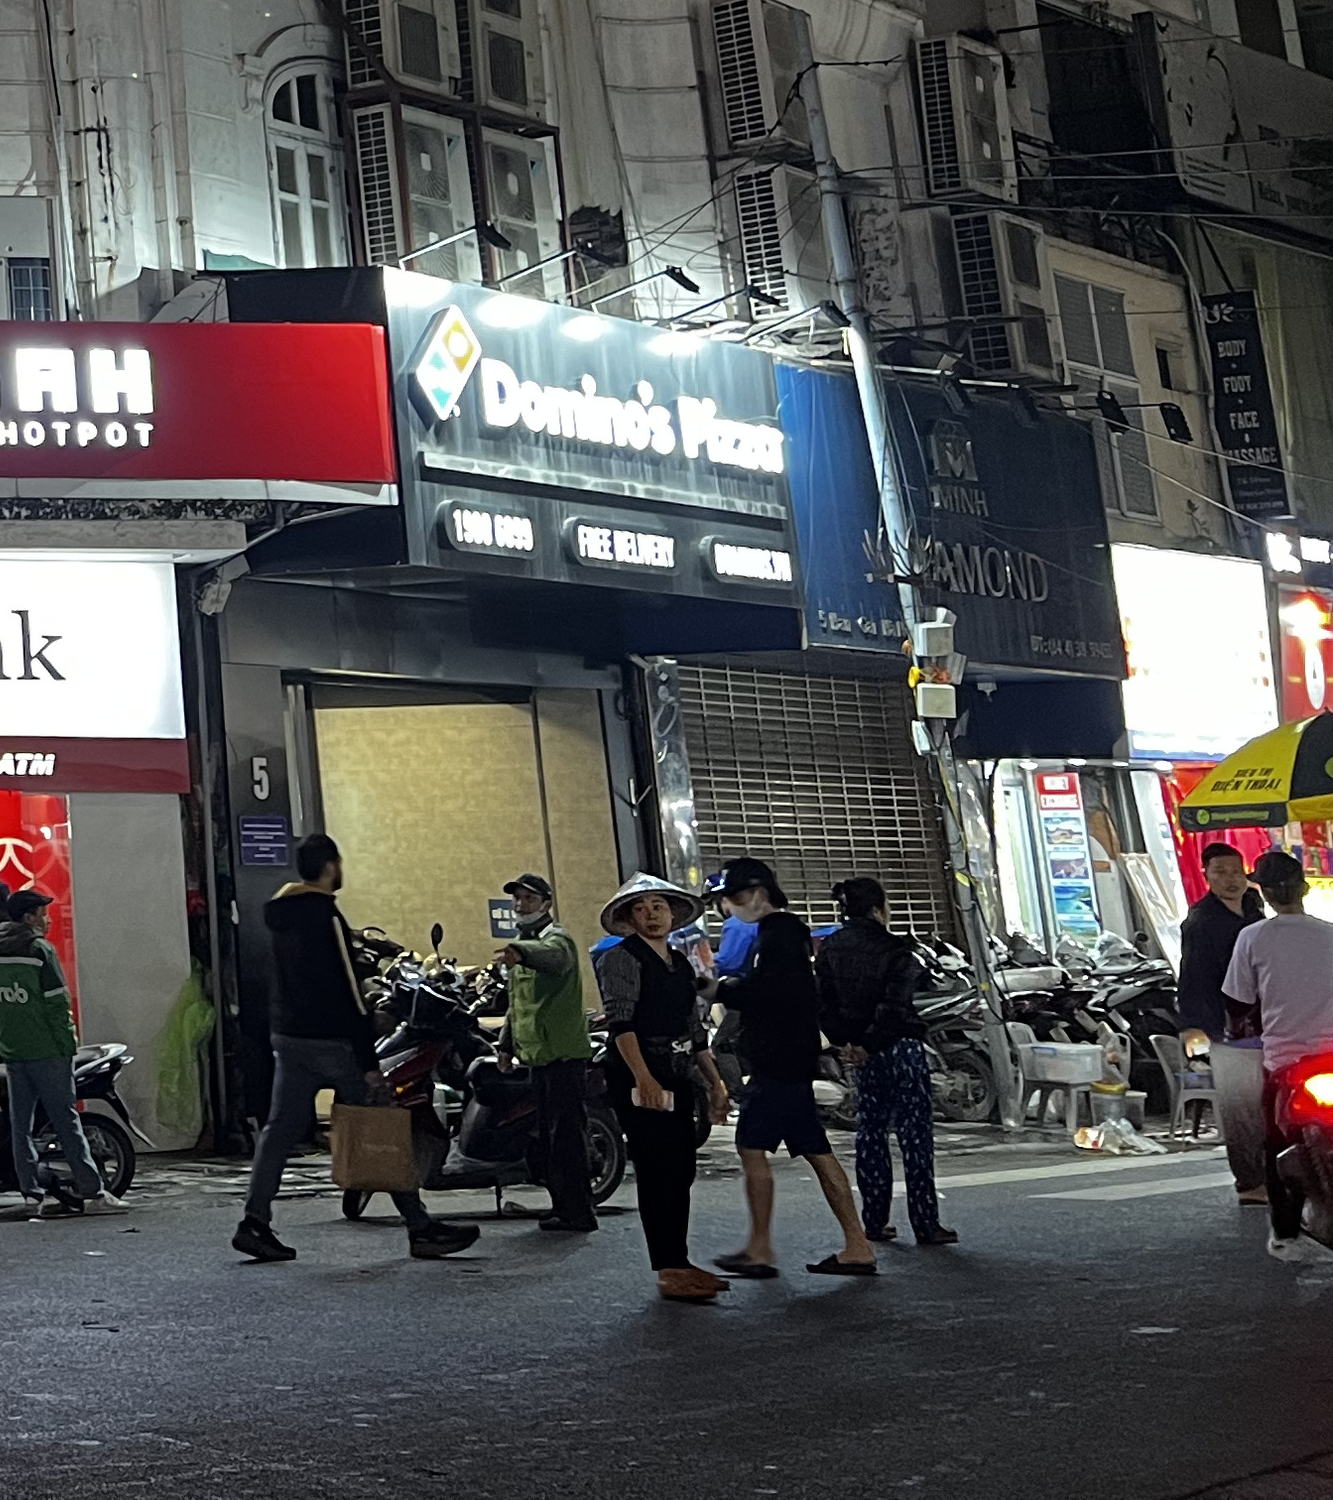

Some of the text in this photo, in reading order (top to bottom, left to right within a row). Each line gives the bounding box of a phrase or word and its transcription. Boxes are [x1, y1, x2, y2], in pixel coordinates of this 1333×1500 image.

[1217, 339, 1247, 358] BODY
[1223, 375, 1252, 394] FOOT
[481, 358, 784, 474] Domino's Pizza
[1229, 411, 1260, 430] FACE
[578, 524, 675, 568] FREE DELIVERY
[252, 757, 270, 800] 5
